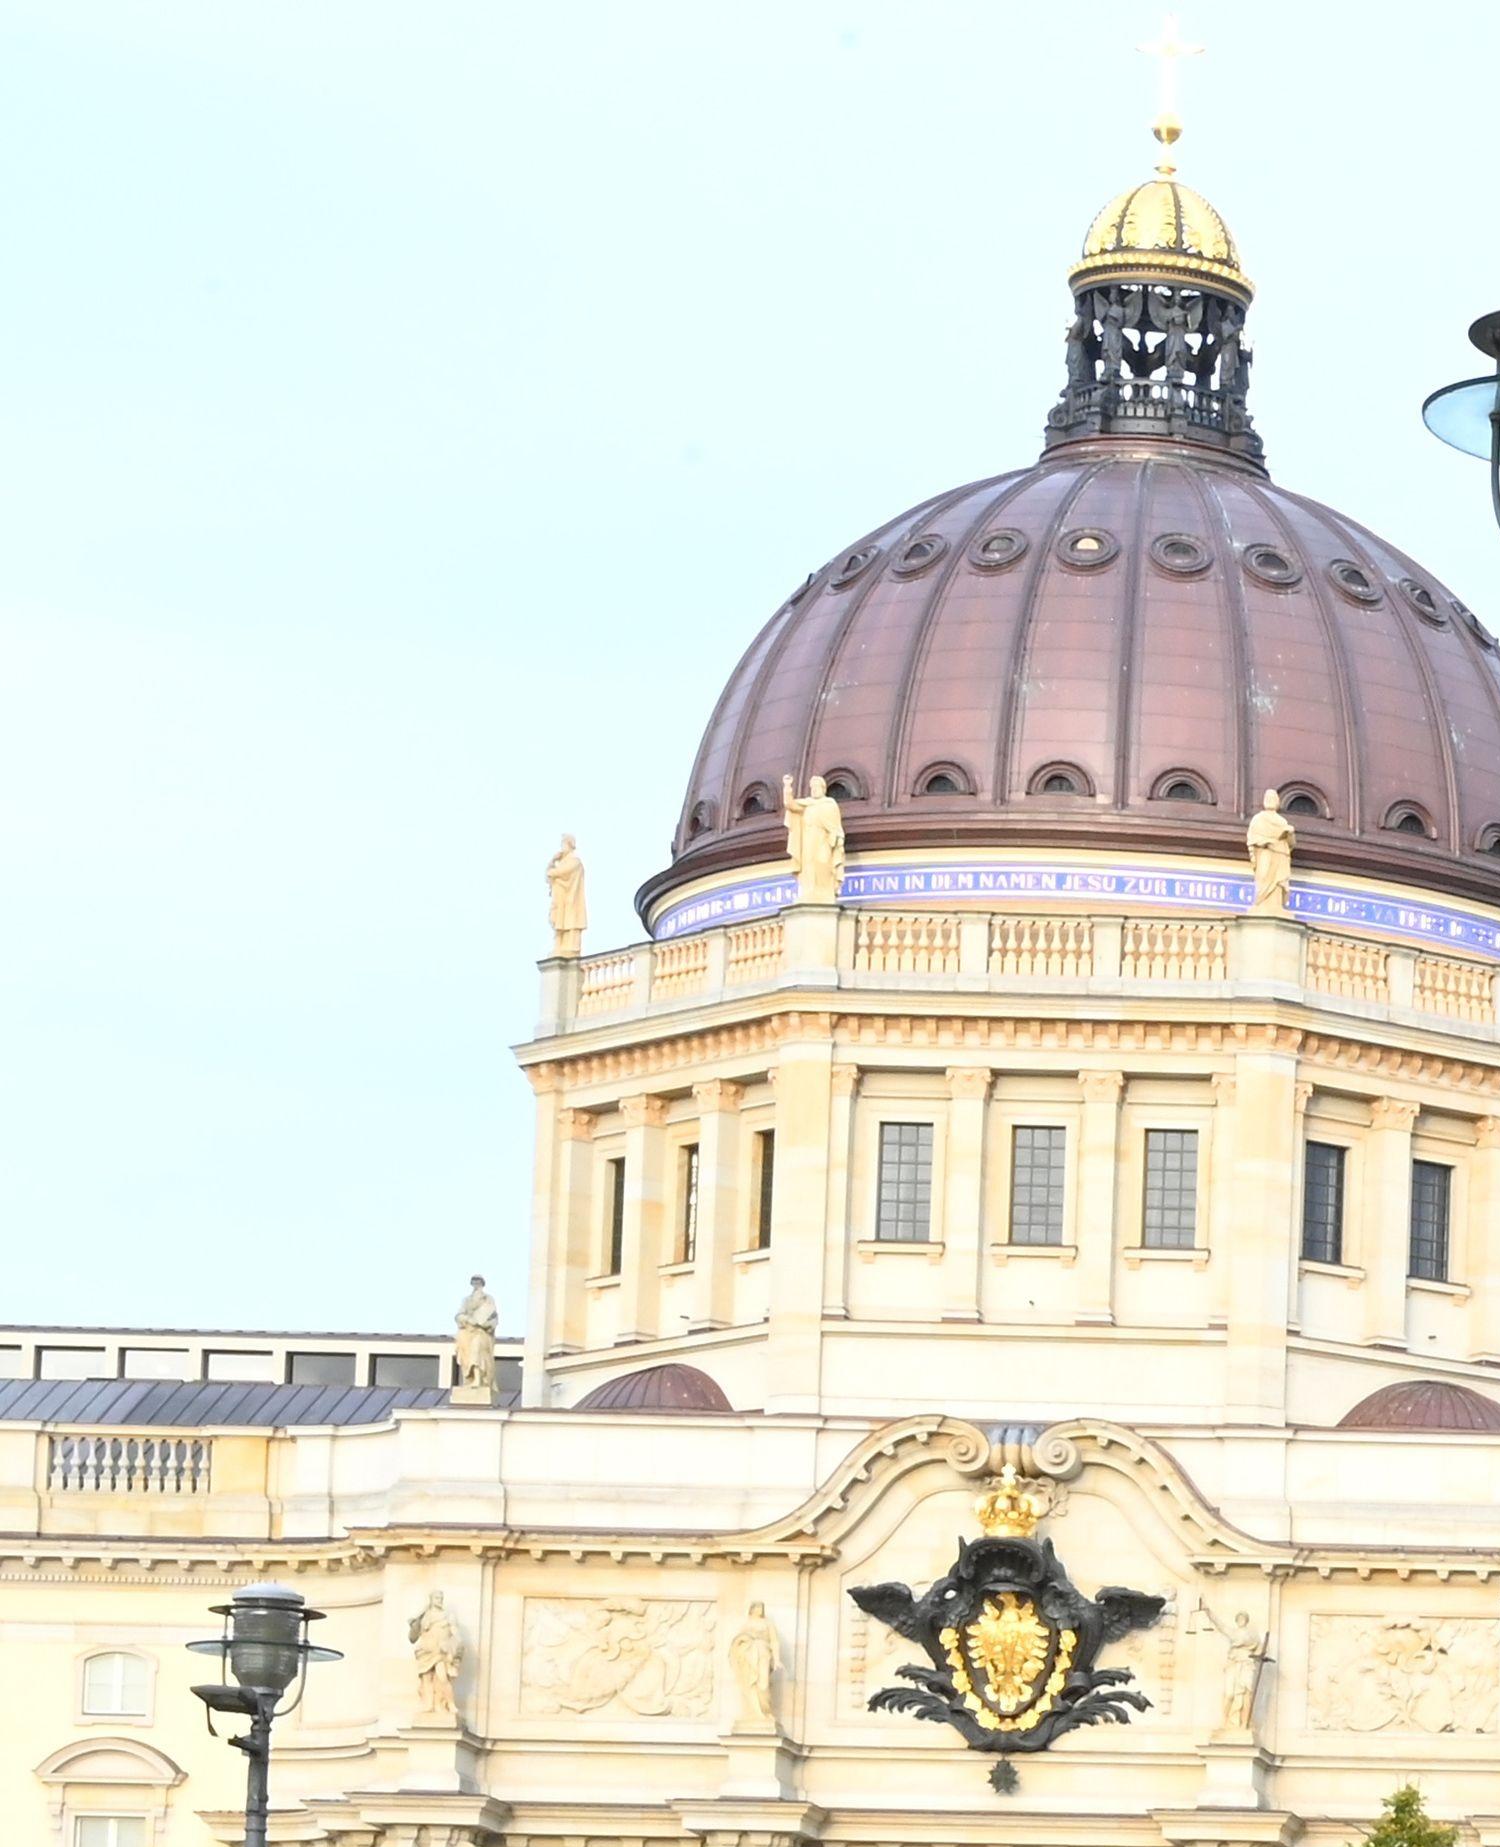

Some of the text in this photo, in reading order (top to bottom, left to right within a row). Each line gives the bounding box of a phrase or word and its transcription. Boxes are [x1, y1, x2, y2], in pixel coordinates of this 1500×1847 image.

[904, 874, 925, 890] IN
[931, 873, 973, 890] DEM
[979, 872, 1056, 890] NAMEN
[1062, 873, 1116, 892] JESU
[1123, 876, 1167, 896] ZUR
